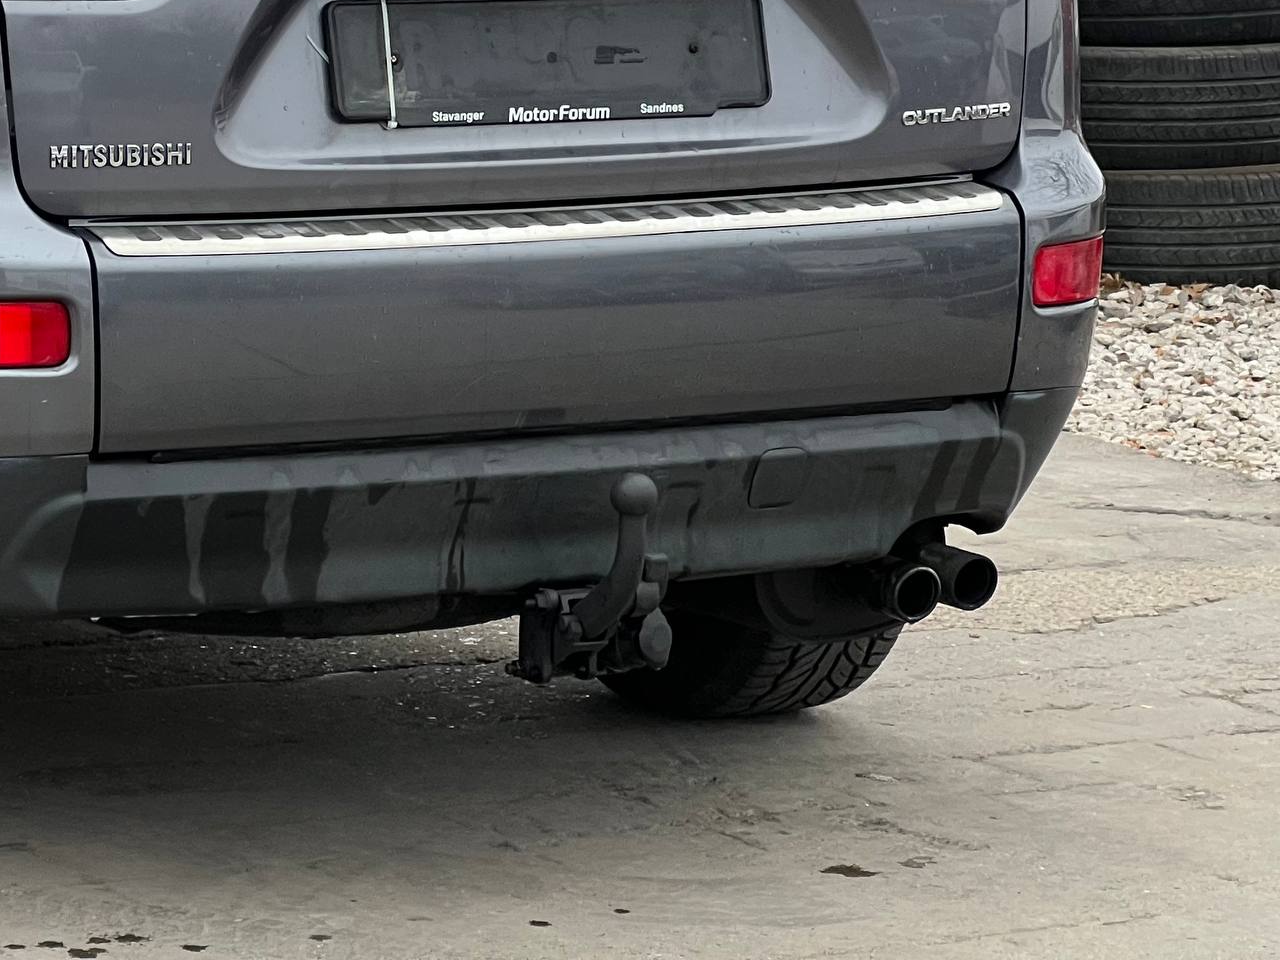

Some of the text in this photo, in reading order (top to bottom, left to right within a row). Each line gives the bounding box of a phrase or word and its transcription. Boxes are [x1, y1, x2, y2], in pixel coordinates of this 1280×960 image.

[432, 102, 684, 123] Stavanger MotorForum Sandnes
[902, 102, 1011, 126] OUTLANDER
[49, 143, 192, 169] MITSUBISHI
